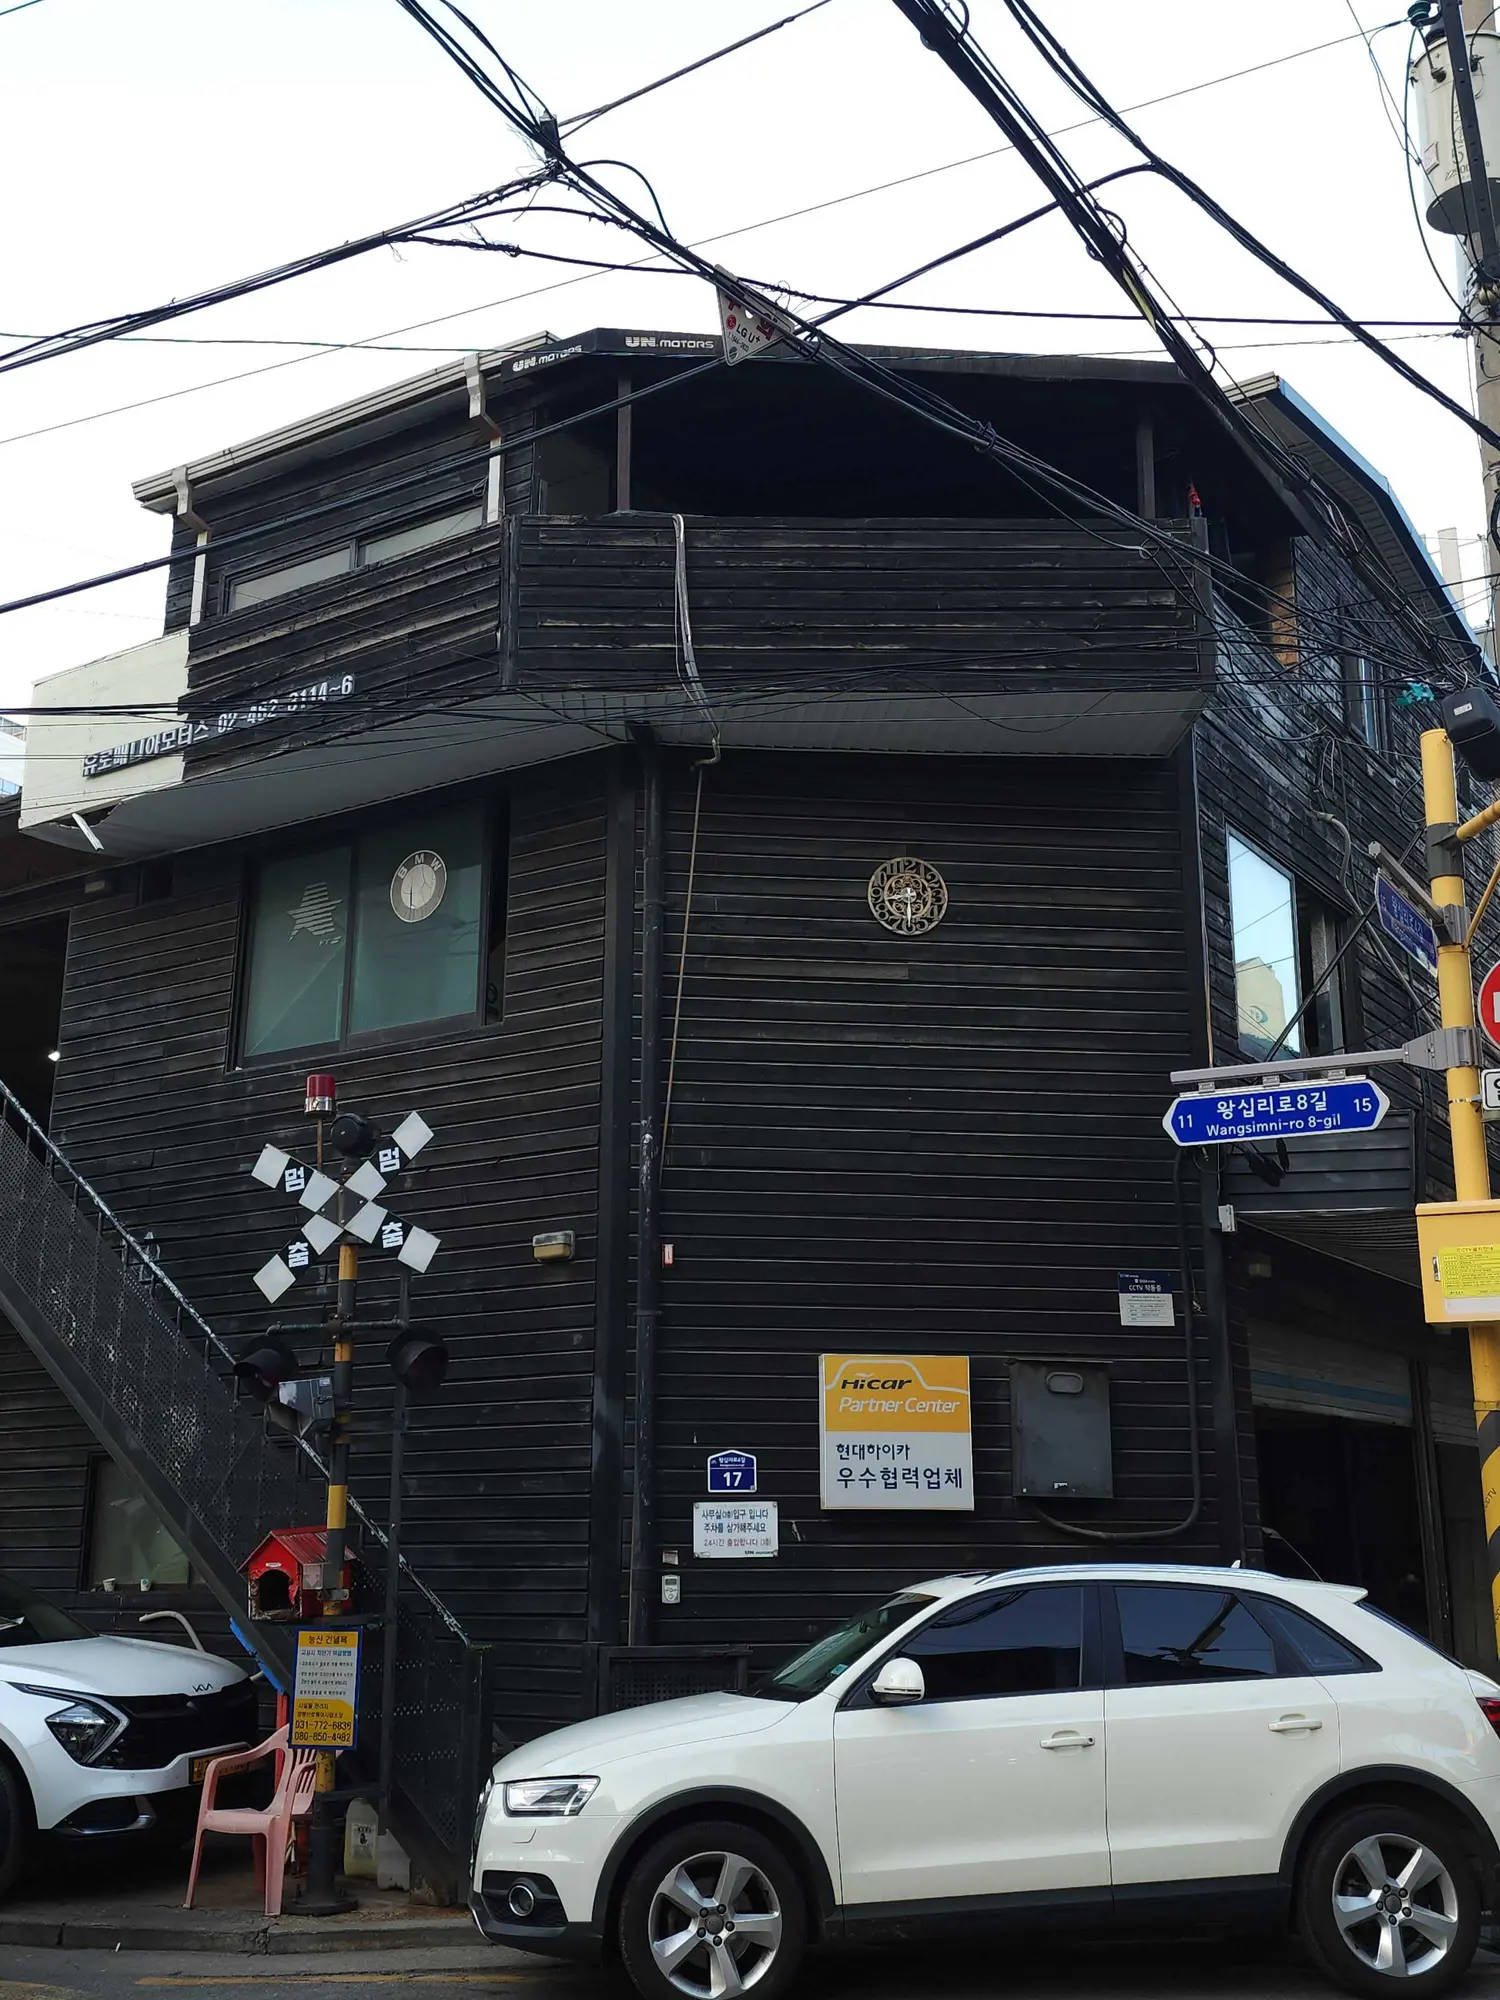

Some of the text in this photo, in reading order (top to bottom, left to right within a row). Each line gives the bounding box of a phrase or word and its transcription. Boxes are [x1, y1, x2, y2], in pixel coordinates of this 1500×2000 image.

[736, 323, 748, 338] LG
[397, 852, 442, 879] BMW
[926, 871, 941, 888] 2
[871, 887, 884, 904] 9
[931, 888, 946, 905] 3
[875, 902, 889, 921] 8
[1177, 1090, 1372, 1129] 11 왕십리로8길 15
[1206, 1113, 1341, 1138] Wangsimni-ro 8-gil
[841, 1379, 912, 1390] Hicar
[838, 1397, 960, 1413] Partner Center
[836, 1443, 911, 1461] 현대하이카
[723, 1472, 742, 1487] 17
[836, 1467, 963, 1489] 우수협력업체
